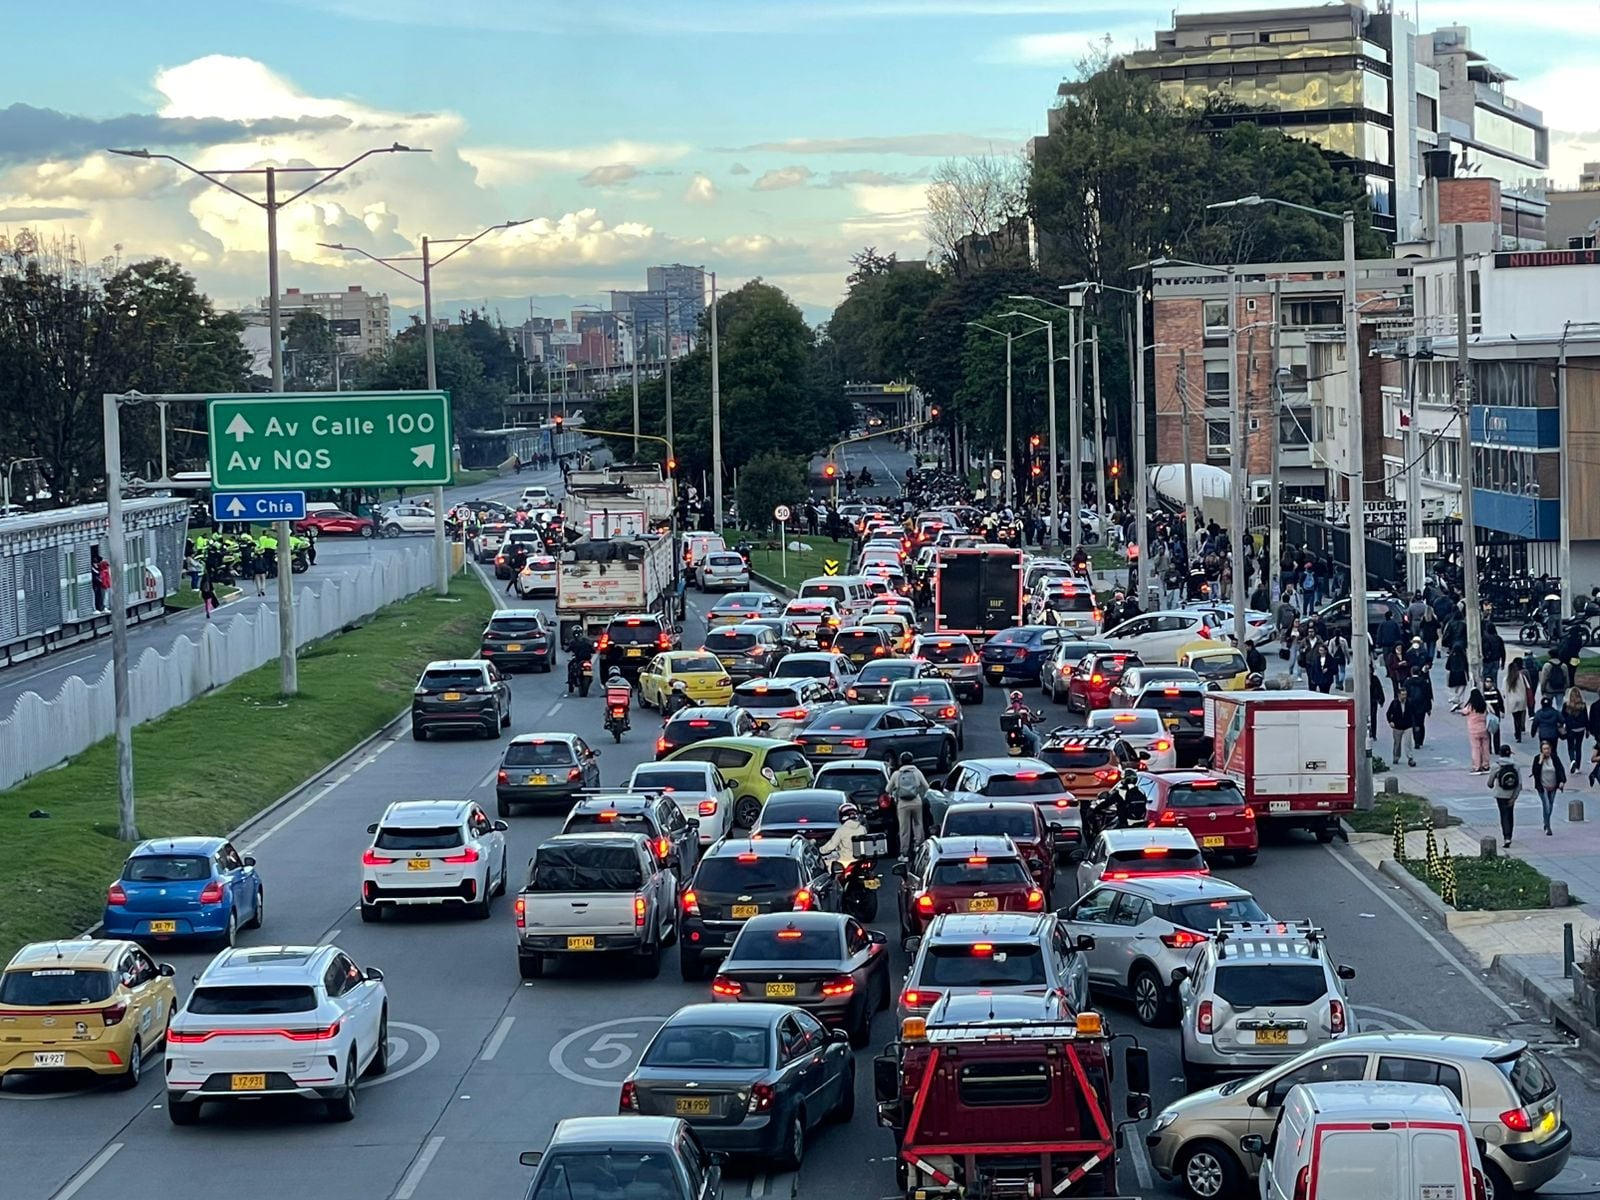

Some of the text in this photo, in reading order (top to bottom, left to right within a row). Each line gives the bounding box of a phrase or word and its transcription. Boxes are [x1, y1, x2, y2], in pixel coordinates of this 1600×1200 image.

[1510, 250, 1594, 266] NOTARIA 9
[265, 413, 435, 437] Av Calle 100
[227, 448, 332, 471] Av NQS
[256, 499, 293, 514] Chía
[459, 510, 469, 518] 50
[778, 509, 788, 517] 50
[584, 1032, 639, 1069] 5
